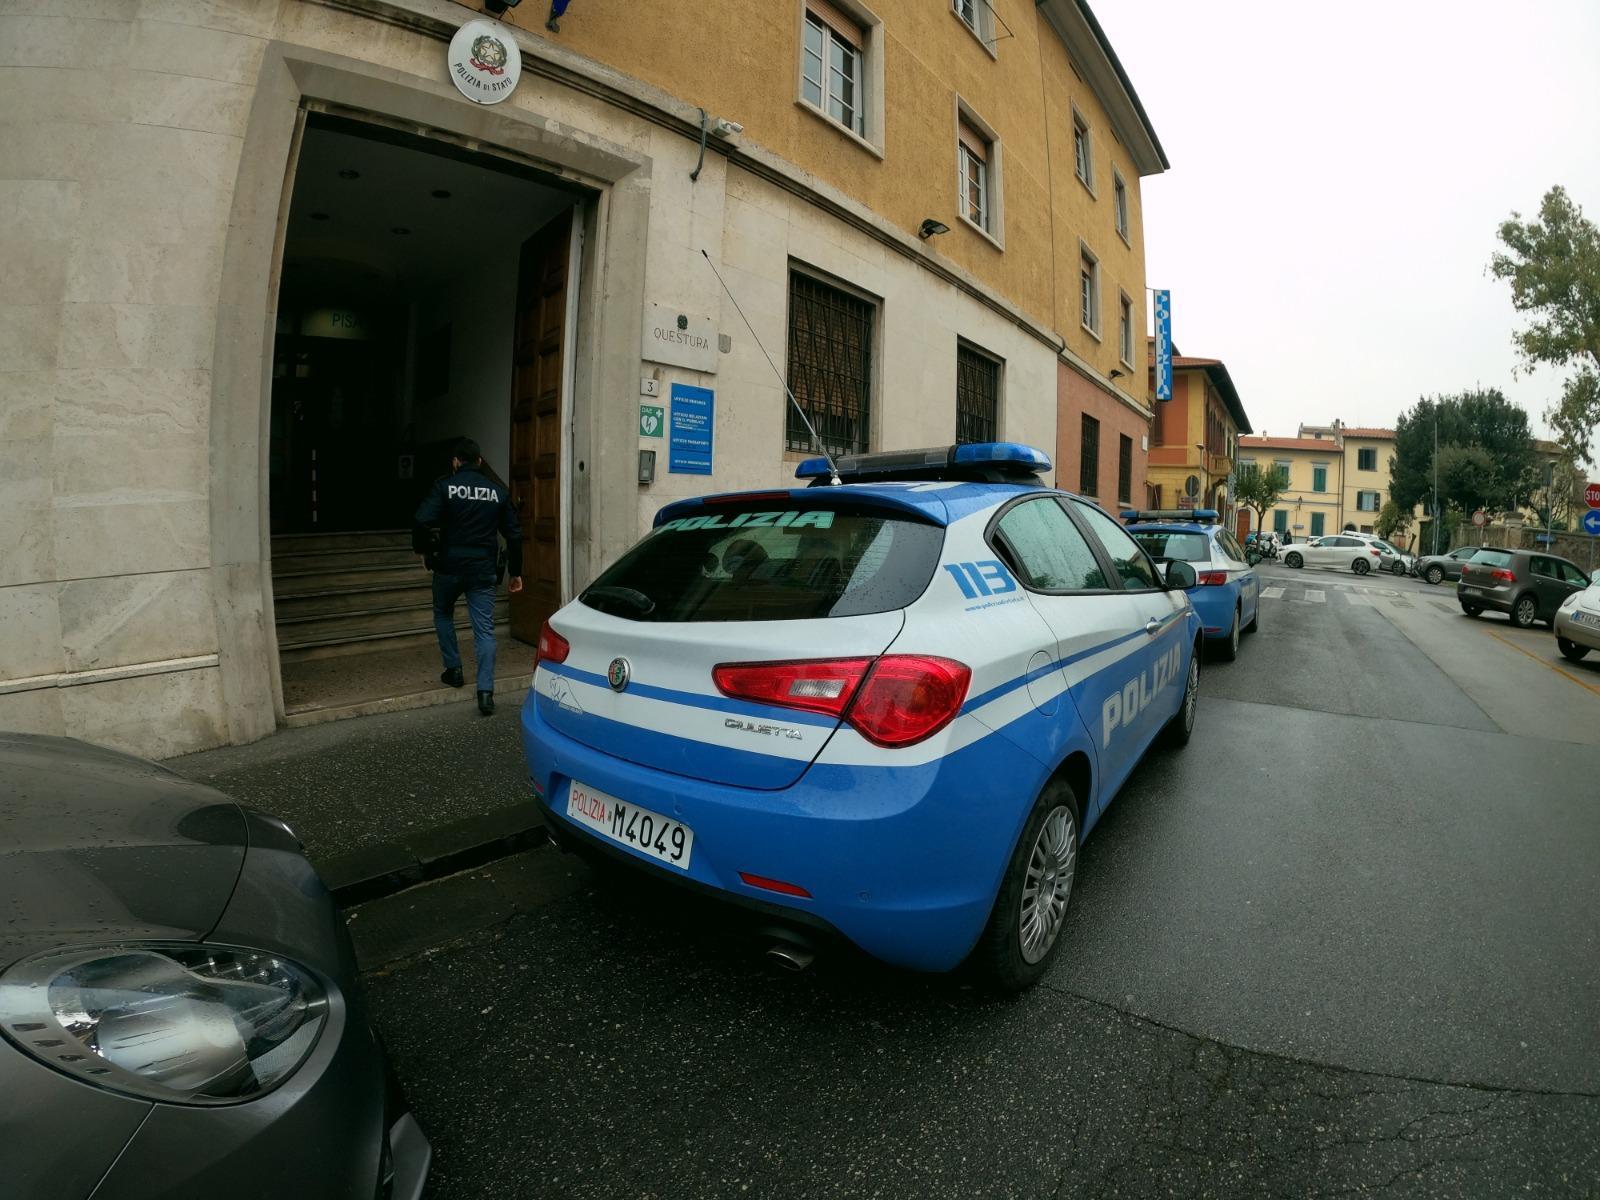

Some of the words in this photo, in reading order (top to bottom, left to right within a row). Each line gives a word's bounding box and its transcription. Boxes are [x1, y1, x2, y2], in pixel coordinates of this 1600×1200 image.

[453, 62, 481, 88] POLIZIA
[492, 77, 513, 91] STATO
[653, 327, 709, 351] QUESTURA
[1156, 294, 1171, 395] POLIZIA
[647, 382, 653, 393] 3
[448, 485, 499, 503] POLIZIA
[1586, 490, 1600, 501] STO
[655, 511, 836, 536] POLIZIA
[943, 560, 1017, 600] 113
[1103, 642, 1181, 751] POLIZIA
[571, 789, 605, 825] POLIZIA
[611, 803, 686, 861] M4049
